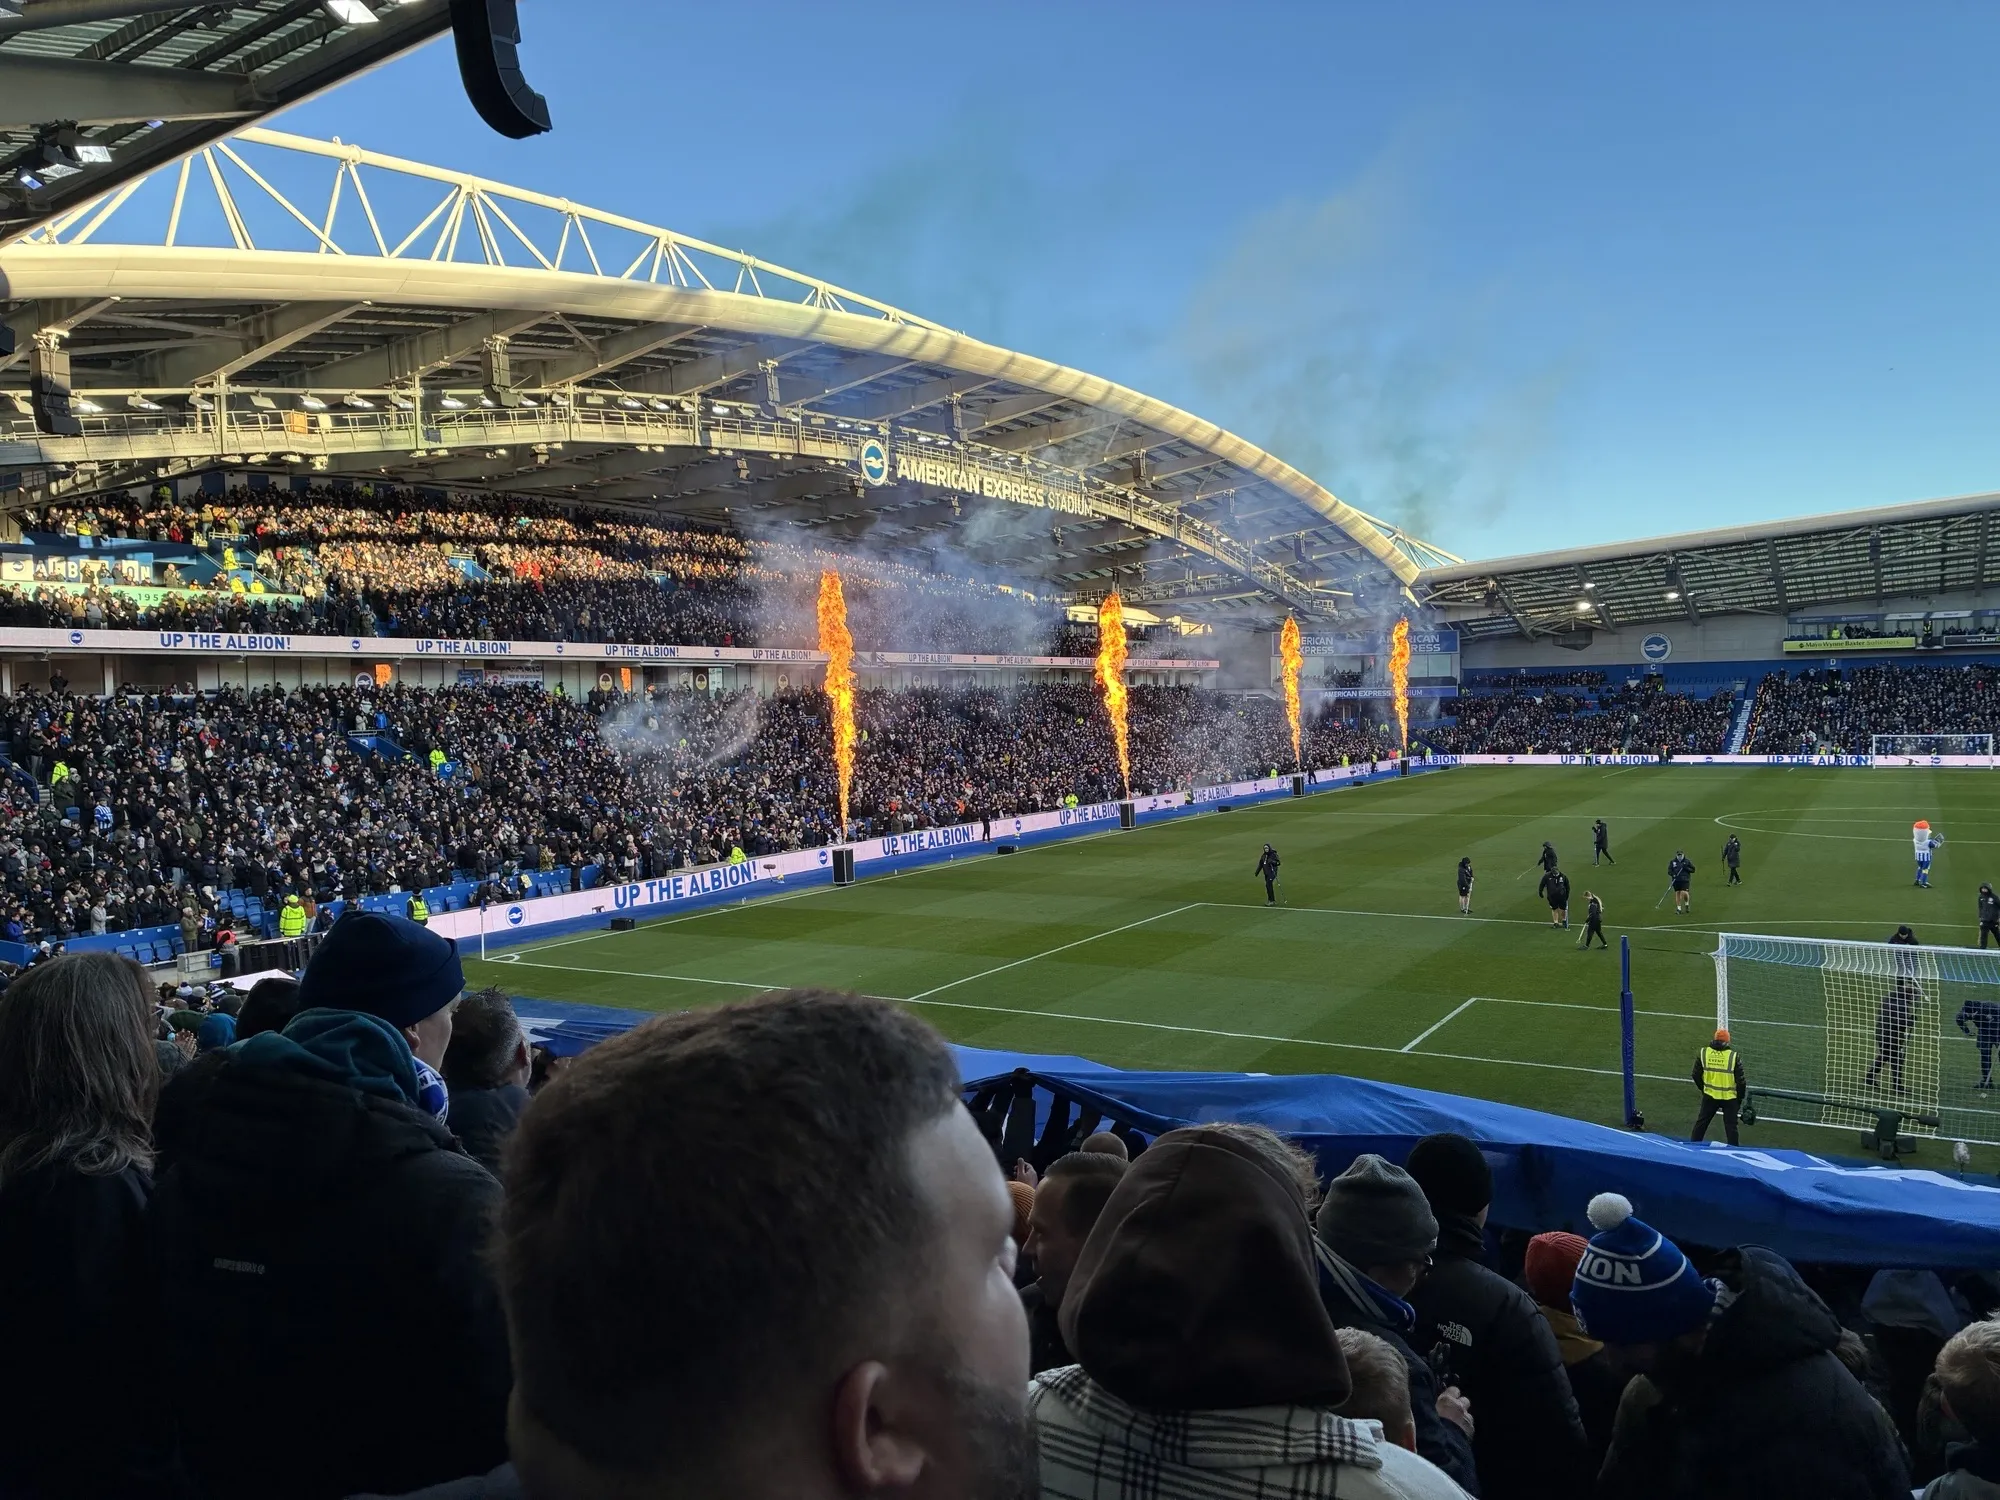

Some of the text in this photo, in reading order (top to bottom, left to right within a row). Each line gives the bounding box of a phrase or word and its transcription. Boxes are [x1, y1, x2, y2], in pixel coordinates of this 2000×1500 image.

[897, 457, 980, 495] AMERICAN
[983, 477, 1045, 508] EXPRESS
[1048, 491, 1093, 518] STADIUM
[160, 633, 291, 650] UP THE ALBION!
[1379, 634, 1440, 643] ARICAN
[1845, 639, 1865, 647] Baxter
[416, 640, 511, 654] UP THE ALBION!
[605, 645, 679, 657] UP THE ALBION!
[1387, 643, 1441, 652] ERESS
[752, 649, 811, 660] UP THE ALBION!
[908, 654, 918, 662] UP
[918, 654, 930, 663] THE
[1830, 658, 1836, 666] D
[1324, 690, 1357, 698] AMERICAN
[1359, 689, 1392, 697] EXPRESS
[1425, 754, 1462, 765] LBION!
[1560, 755, 1576, 764] UP
[1604, 755, 1654, 765] ALBION!
[1767, 755, 1784, 763] UP
[1789, 755, 1814, 763] THE
[1194, 785, 1232, 801] THE ALBION!
[1059, 803, 1120, 825] UP THE ALBION
[882, 825, 974, 855] UP THE ALBION!
[614, 861, 758, 909] UP THE ALBION!
[1577, 1250, 1642, 1284] ION
[1437, 1323, 1461, 1337] NORTH
[1448, 1320, 1462, 1331] THE
[1442, 1330, 1460, 1342] FACE
